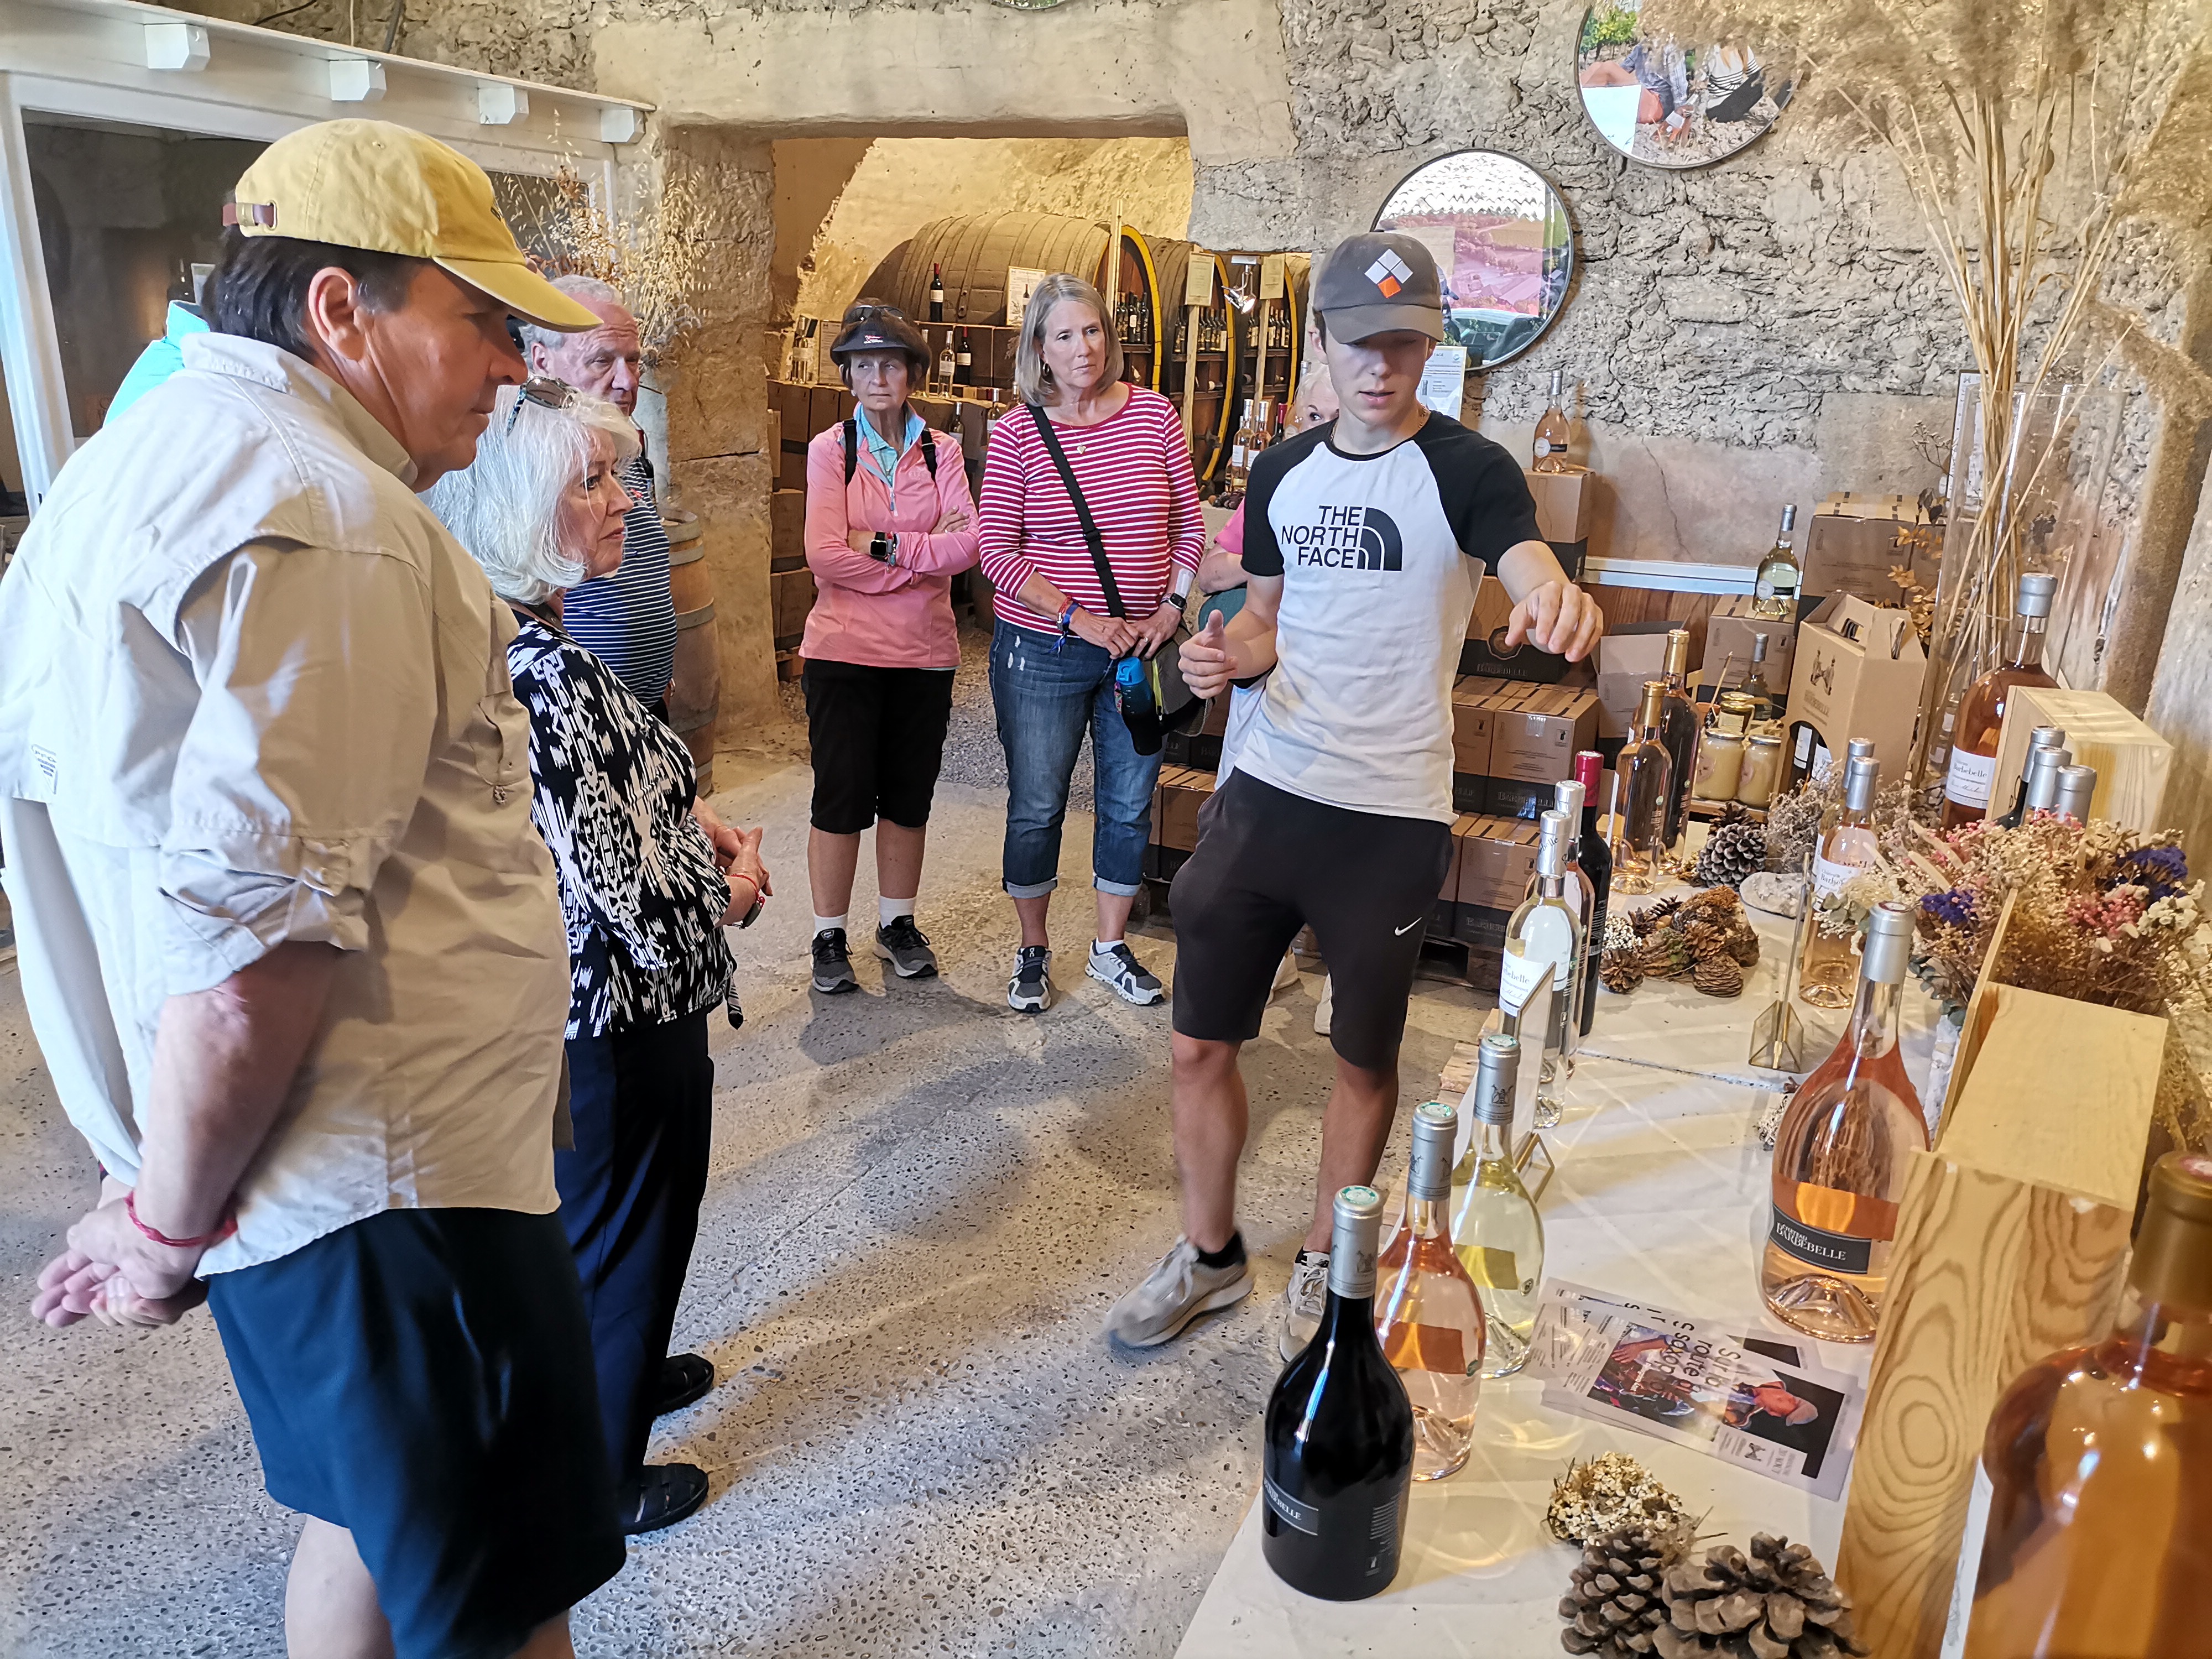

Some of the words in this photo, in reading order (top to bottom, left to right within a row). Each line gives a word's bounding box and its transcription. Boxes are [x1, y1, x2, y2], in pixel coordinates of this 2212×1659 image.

[1318, 505, 1362, 525] THE
[1281, 525, 1358, 547] NORTH
[1298, 546, 1355, 568] FACE
[1776, 1222, 1847, 1261] BARBEBELLE
[1683, 1339, 1713, 1378] route
[1713, 1348, 1741, 1373] Sur
[1704, 1371, 1731, 1388] la
